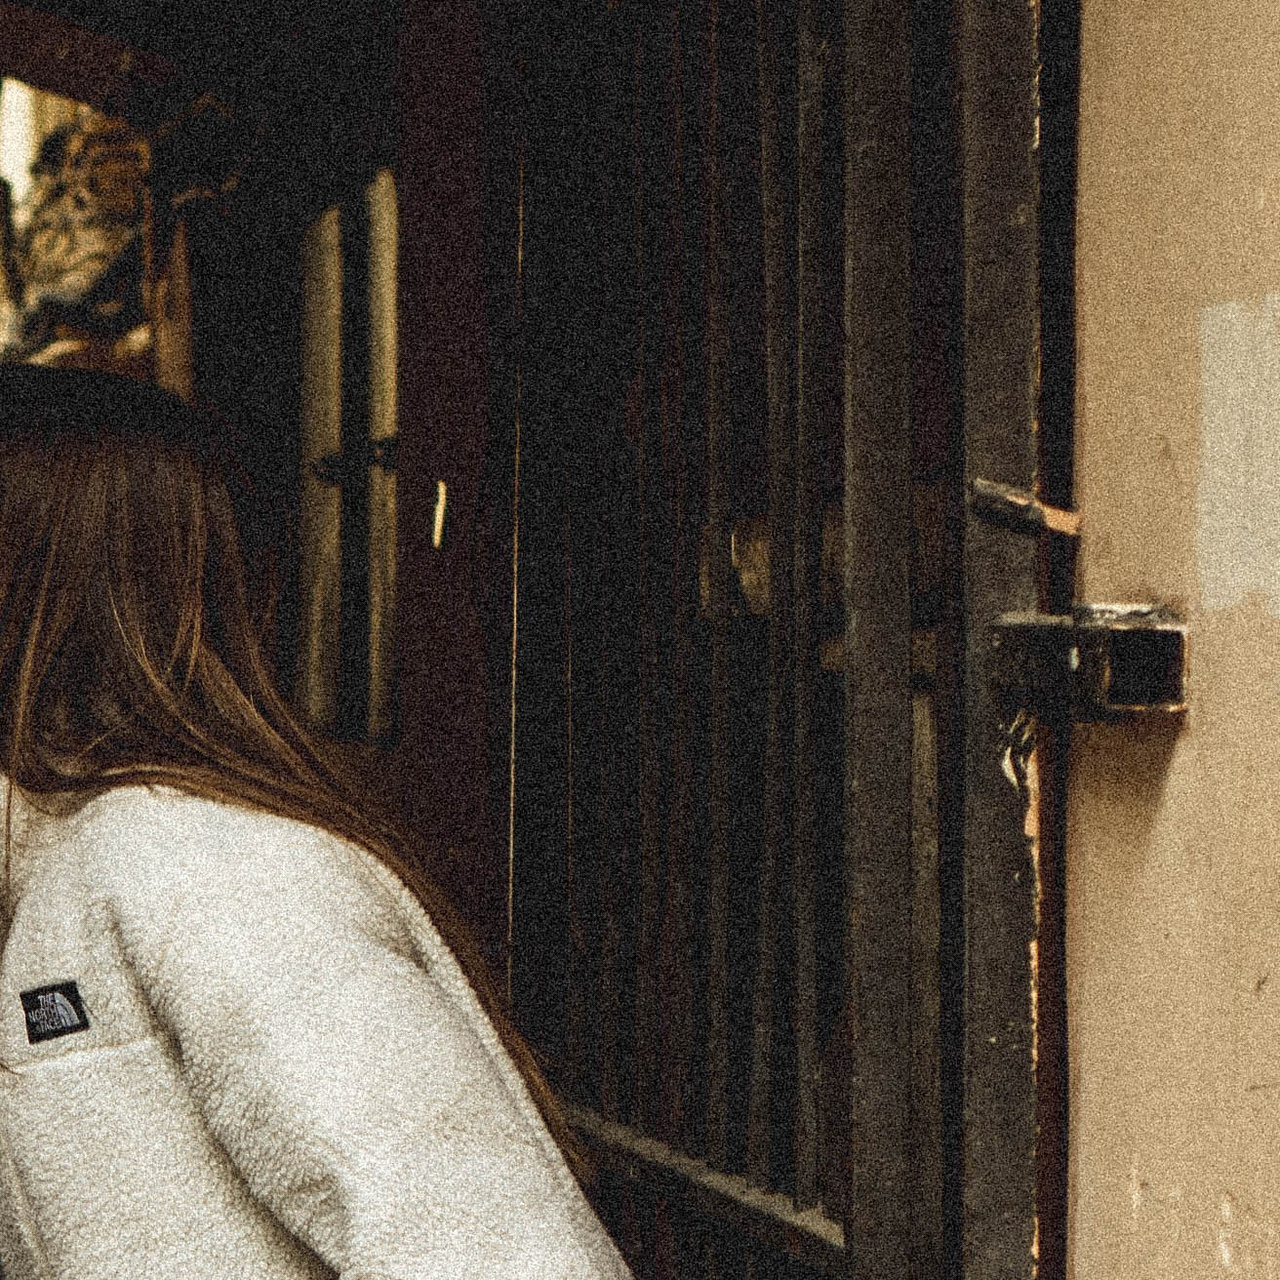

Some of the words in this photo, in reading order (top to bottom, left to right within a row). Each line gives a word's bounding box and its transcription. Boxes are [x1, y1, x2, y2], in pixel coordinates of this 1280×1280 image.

[38, 992, 56, 1008] THE
[28, 1004, 60, 1023] NORTH
[40, 1017, 62, 1033] FACE
